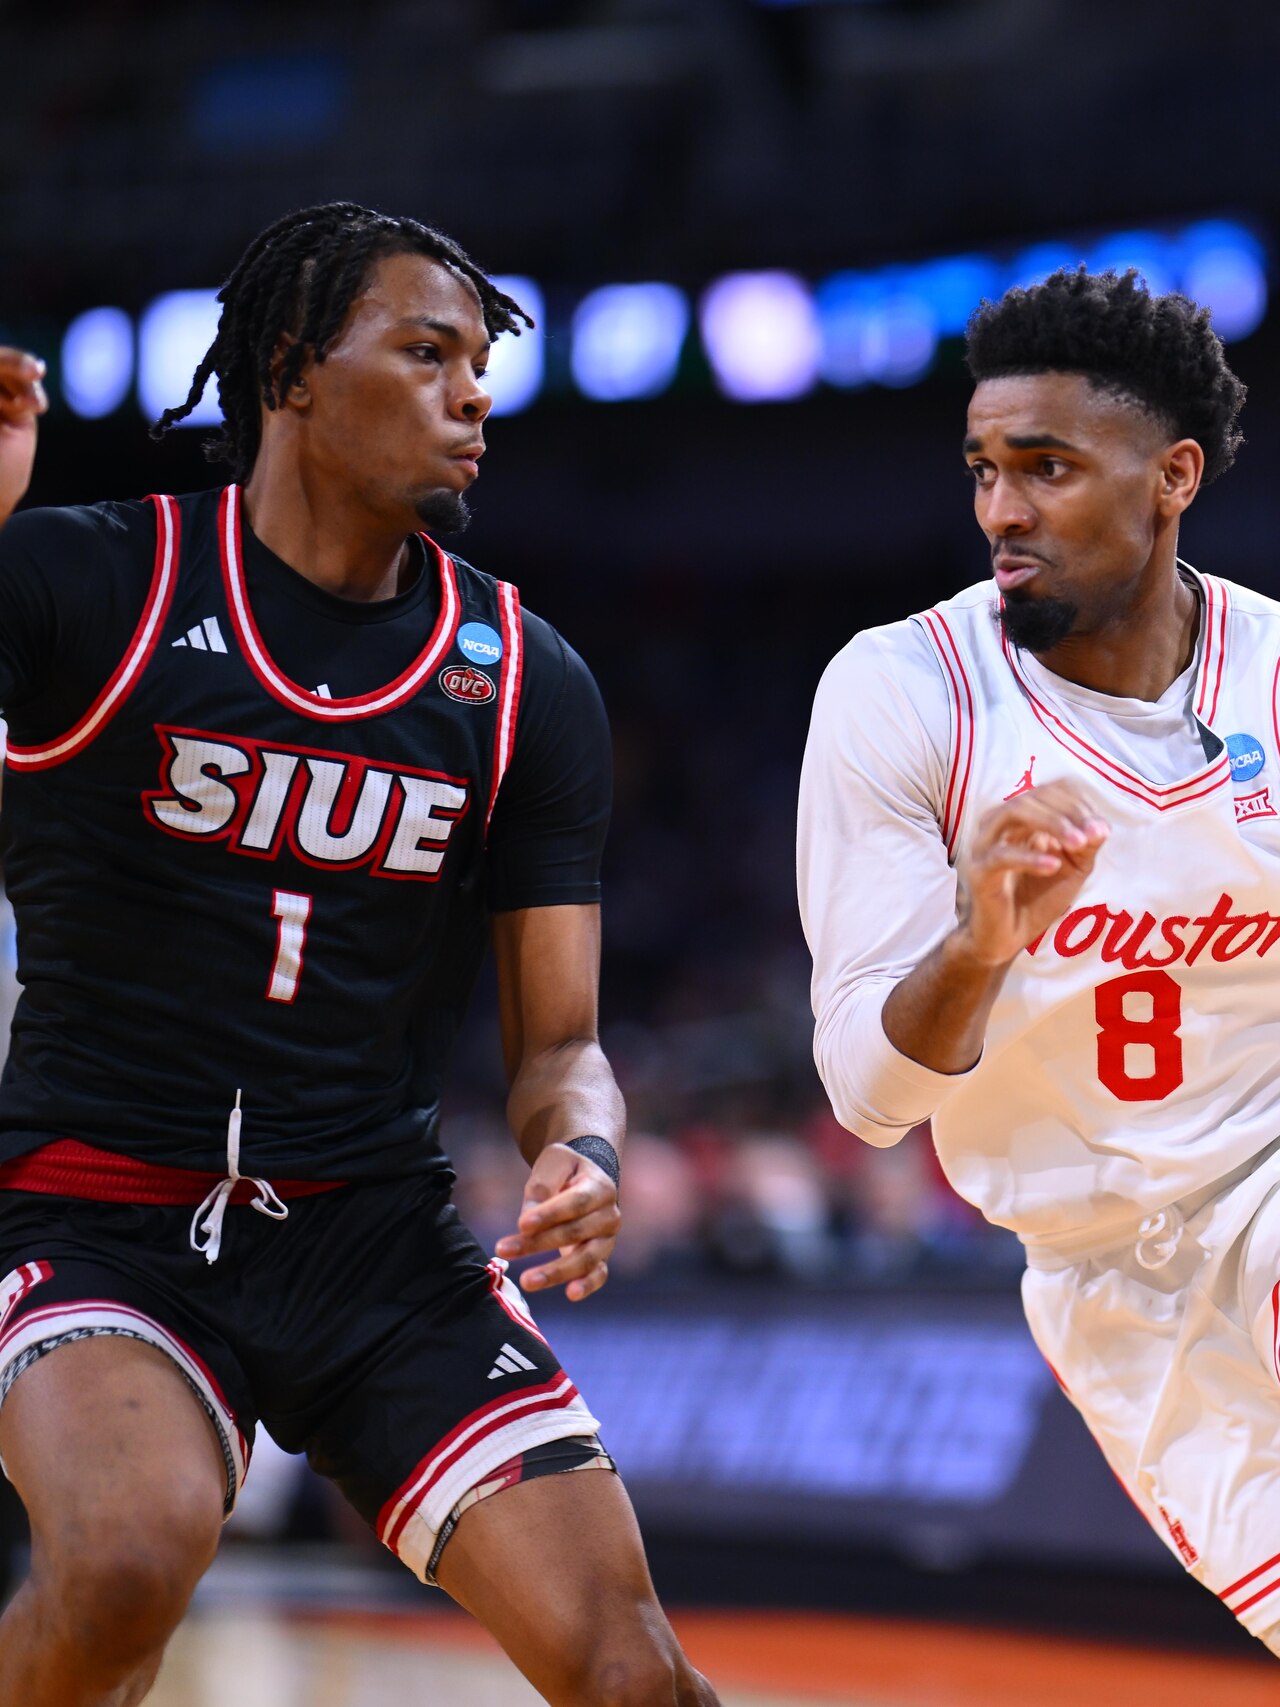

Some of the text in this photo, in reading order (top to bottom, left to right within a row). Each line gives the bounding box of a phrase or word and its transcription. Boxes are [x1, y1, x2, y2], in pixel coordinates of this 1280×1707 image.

[449, 675, 485, 696] OVC
[463, 638, 500, 658] NCAA
[142, 725, 471, 882] SIUE
[266, 889, 312, 1004] 1
[1095, 970, 1183, 1101] 8
